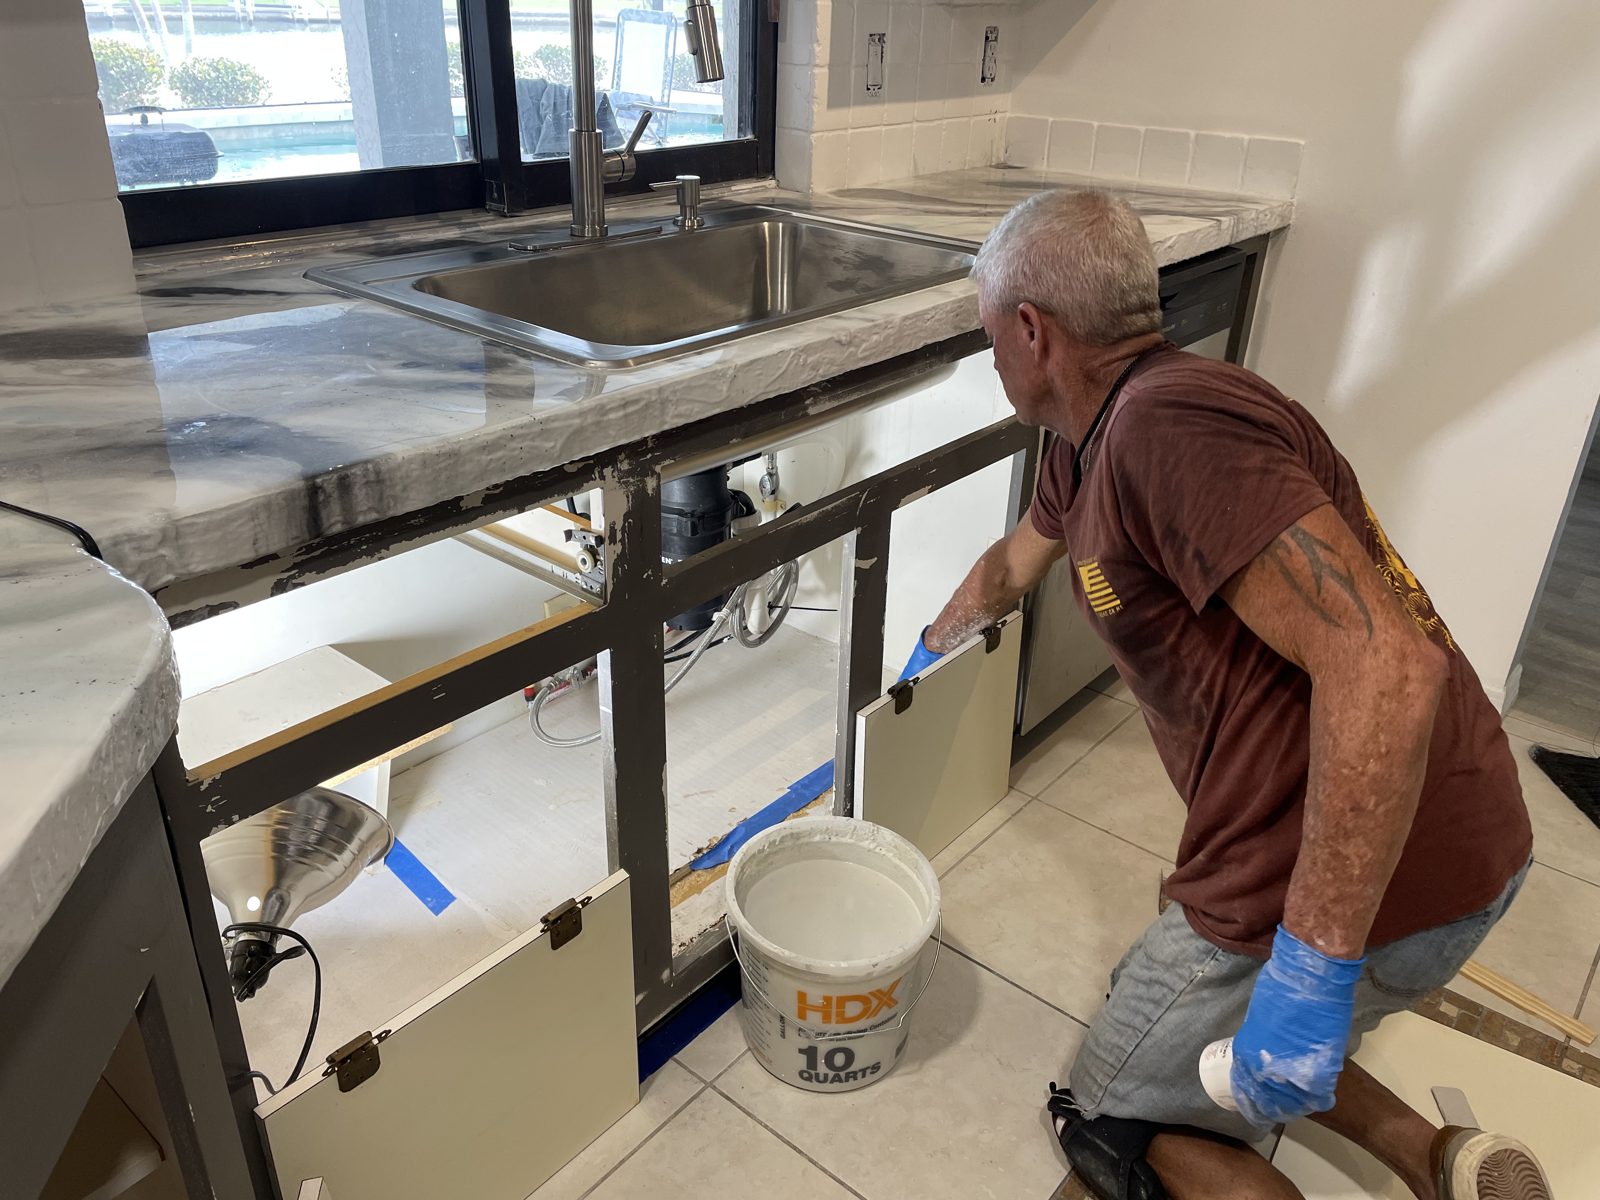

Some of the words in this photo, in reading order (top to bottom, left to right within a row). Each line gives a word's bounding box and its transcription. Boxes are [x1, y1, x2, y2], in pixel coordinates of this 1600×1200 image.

[797, 976, 902, 1024] HDX
[798, 1045, 856, 1073] 10
[798, 1061, 882, 1084] QUARTS
